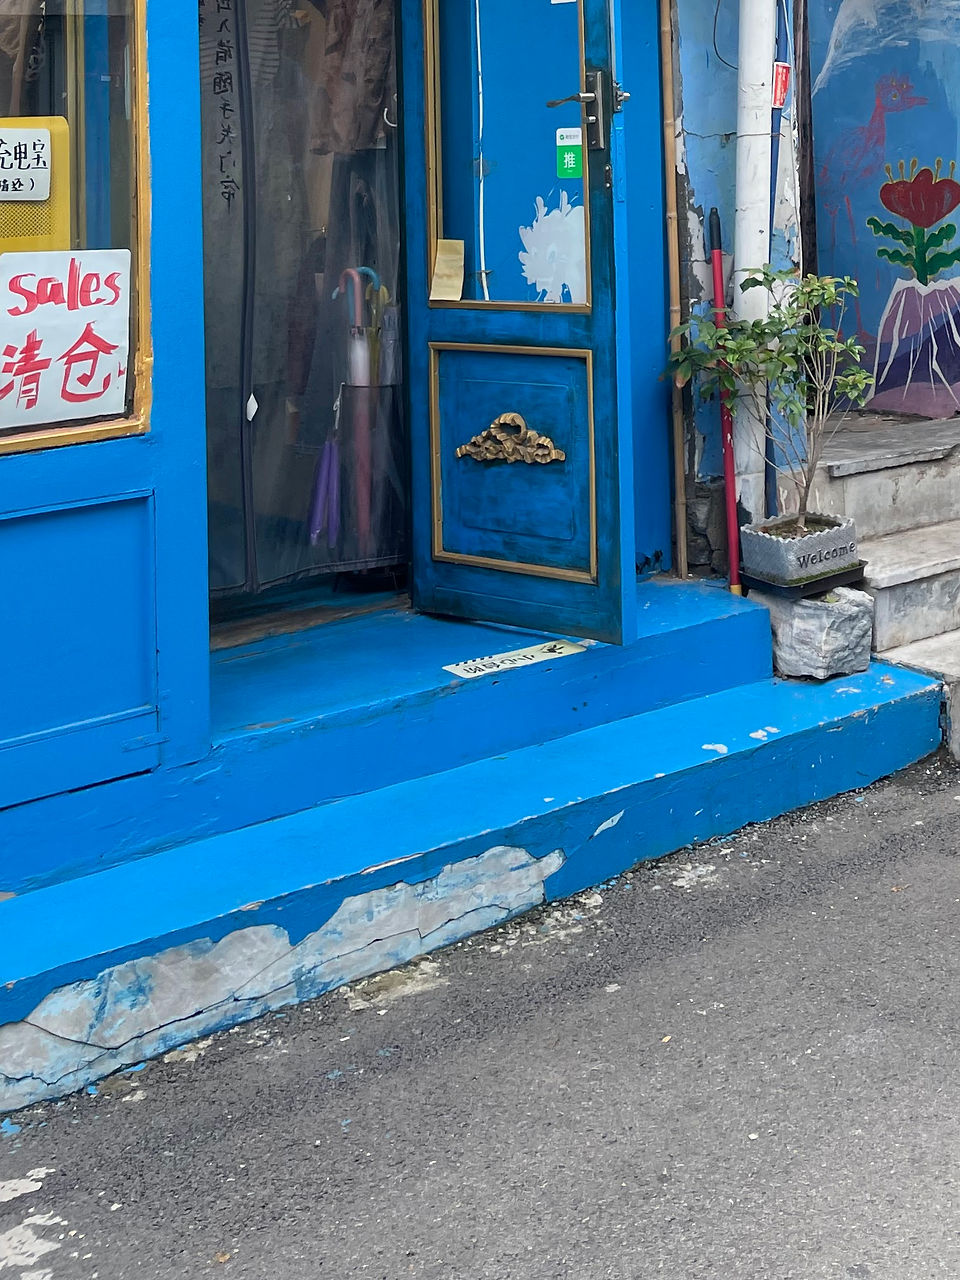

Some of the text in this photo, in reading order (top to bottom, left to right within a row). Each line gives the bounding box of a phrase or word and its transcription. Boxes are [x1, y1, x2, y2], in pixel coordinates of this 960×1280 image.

[563, 151, 576, 169] 推
[0, 321, 120, 410] 清仓
[797, 541, 856, 569] Welcome
